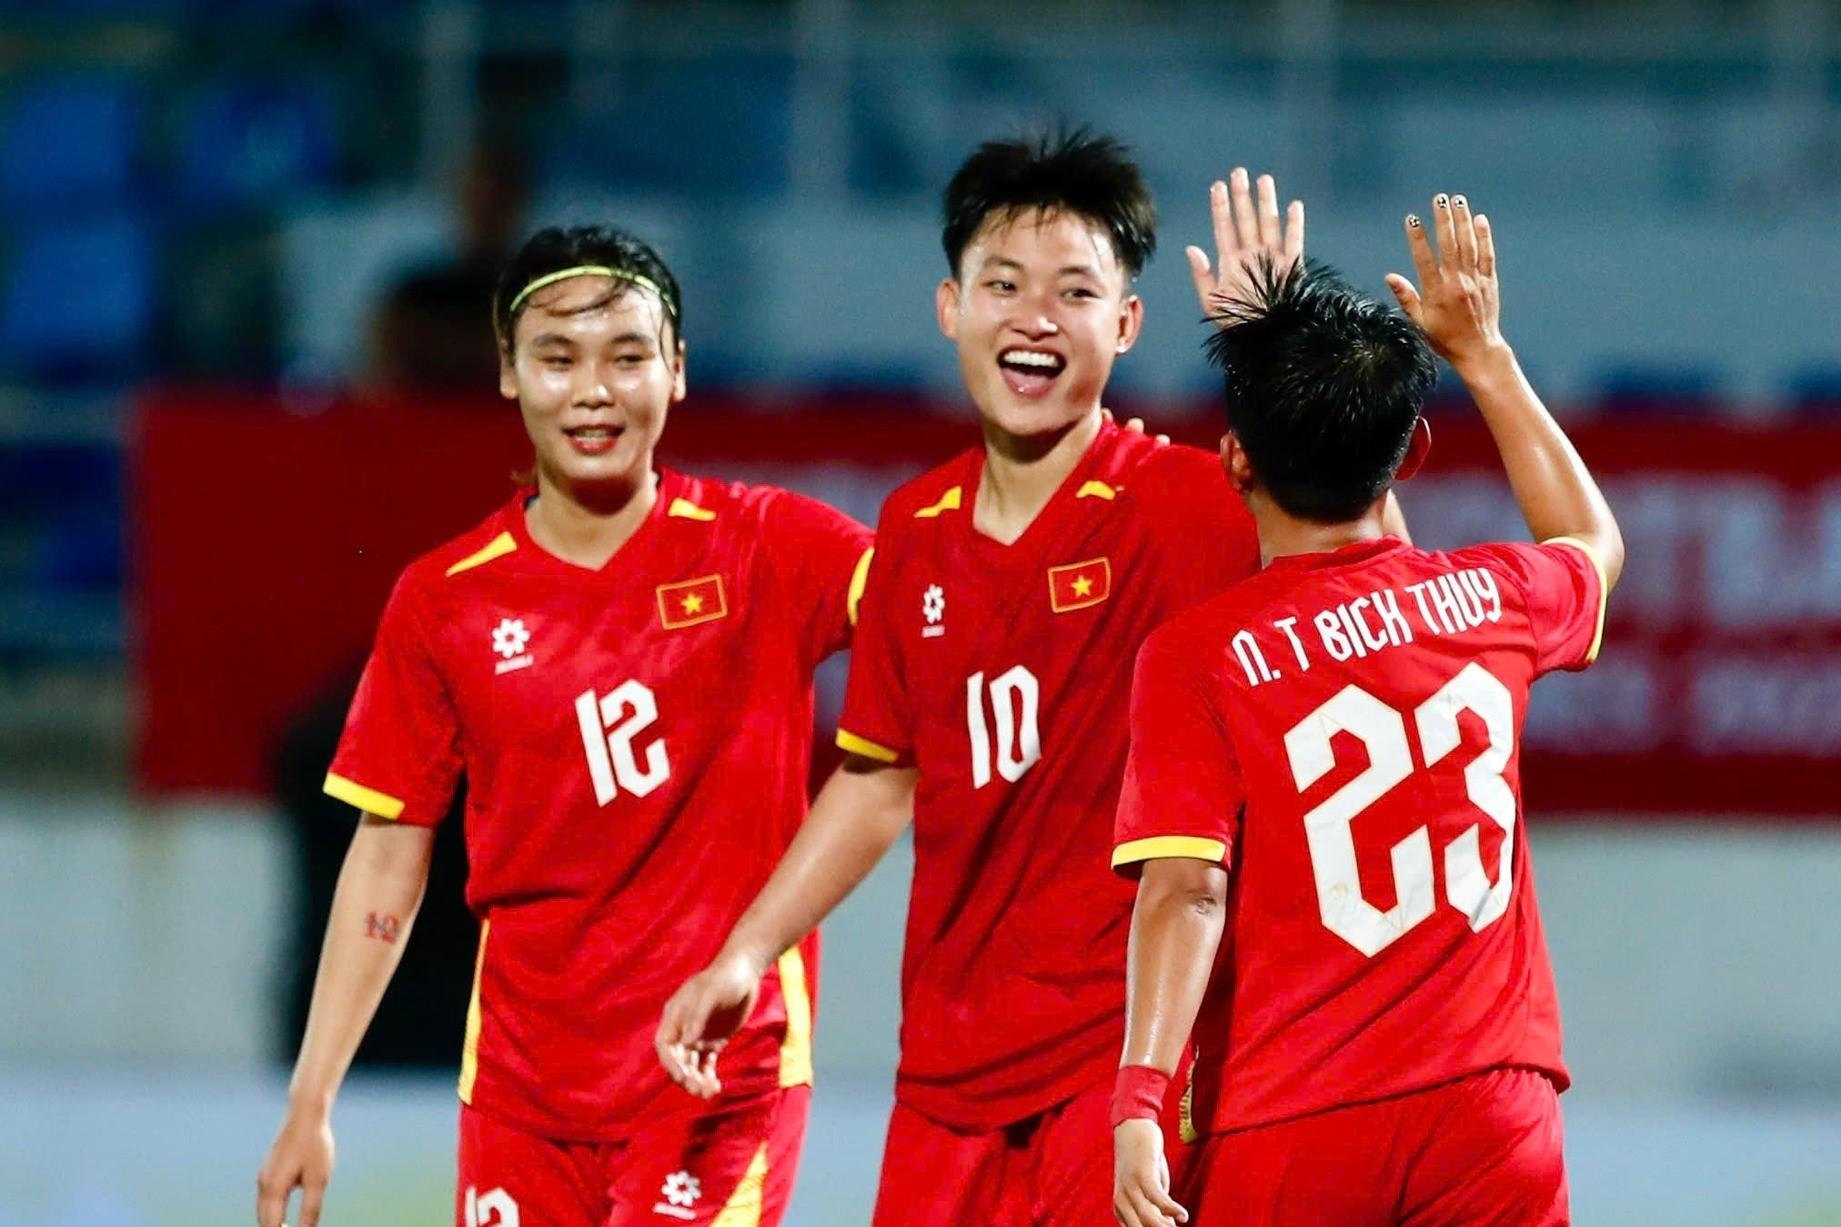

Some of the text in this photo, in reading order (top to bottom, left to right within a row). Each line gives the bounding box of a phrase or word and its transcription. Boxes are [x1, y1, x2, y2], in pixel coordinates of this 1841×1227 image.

[1273, 616, 1310, 672] T
[1313, 588, 1414, 662] BICH
[1402, 567, 1505, 636] THUY
[574, 678, 671, 807] 12
[966, 665, 1042, 789] 10
[1283, 661, 1517, 958] 23
